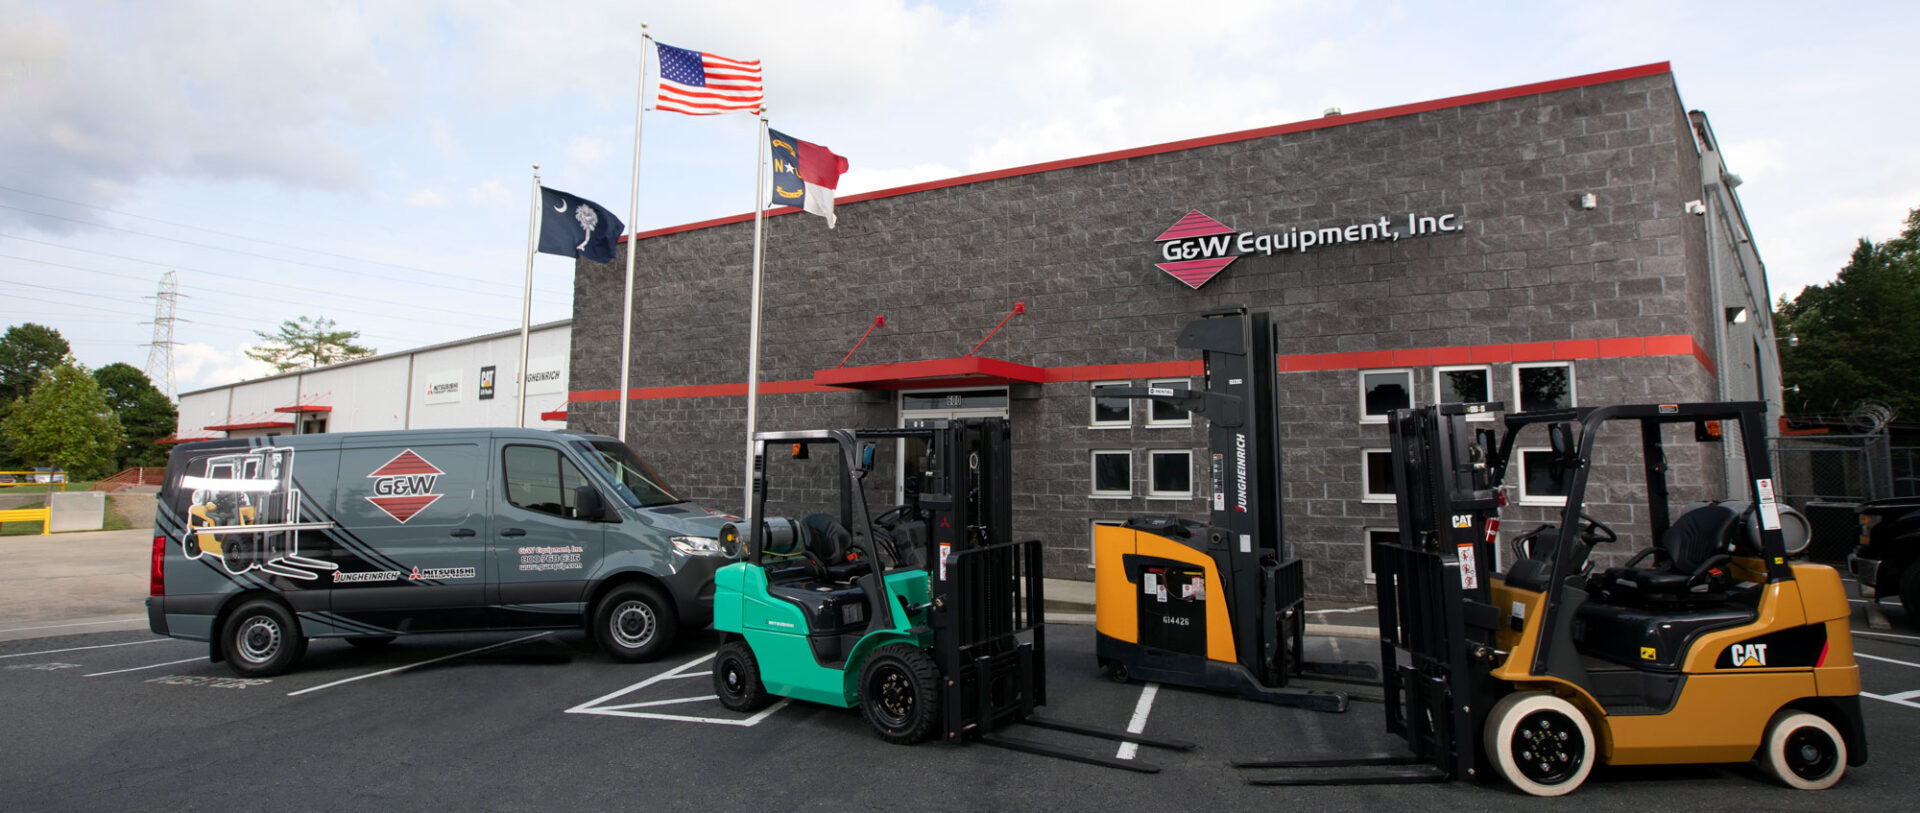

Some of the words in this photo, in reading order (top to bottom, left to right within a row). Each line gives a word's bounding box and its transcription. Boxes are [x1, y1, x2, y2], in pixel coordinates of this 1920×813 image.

[1162, 235, 1231, 260] G&W
[1237, 216, 1399, 255] Equipment,
[1409, 213, 1464, 235] Inc.
[1235, 433, 1247, 512] JUNGHEINRICH
[375, 475, 436, 495] G&W
[1452, 514, 1472, 528] CAT
[333, 571, 399, 582] JUNGHEINRICH
[423, 568, 475, 576] MITSUBISHI
[1731, 644, 1768, 667] CAT
